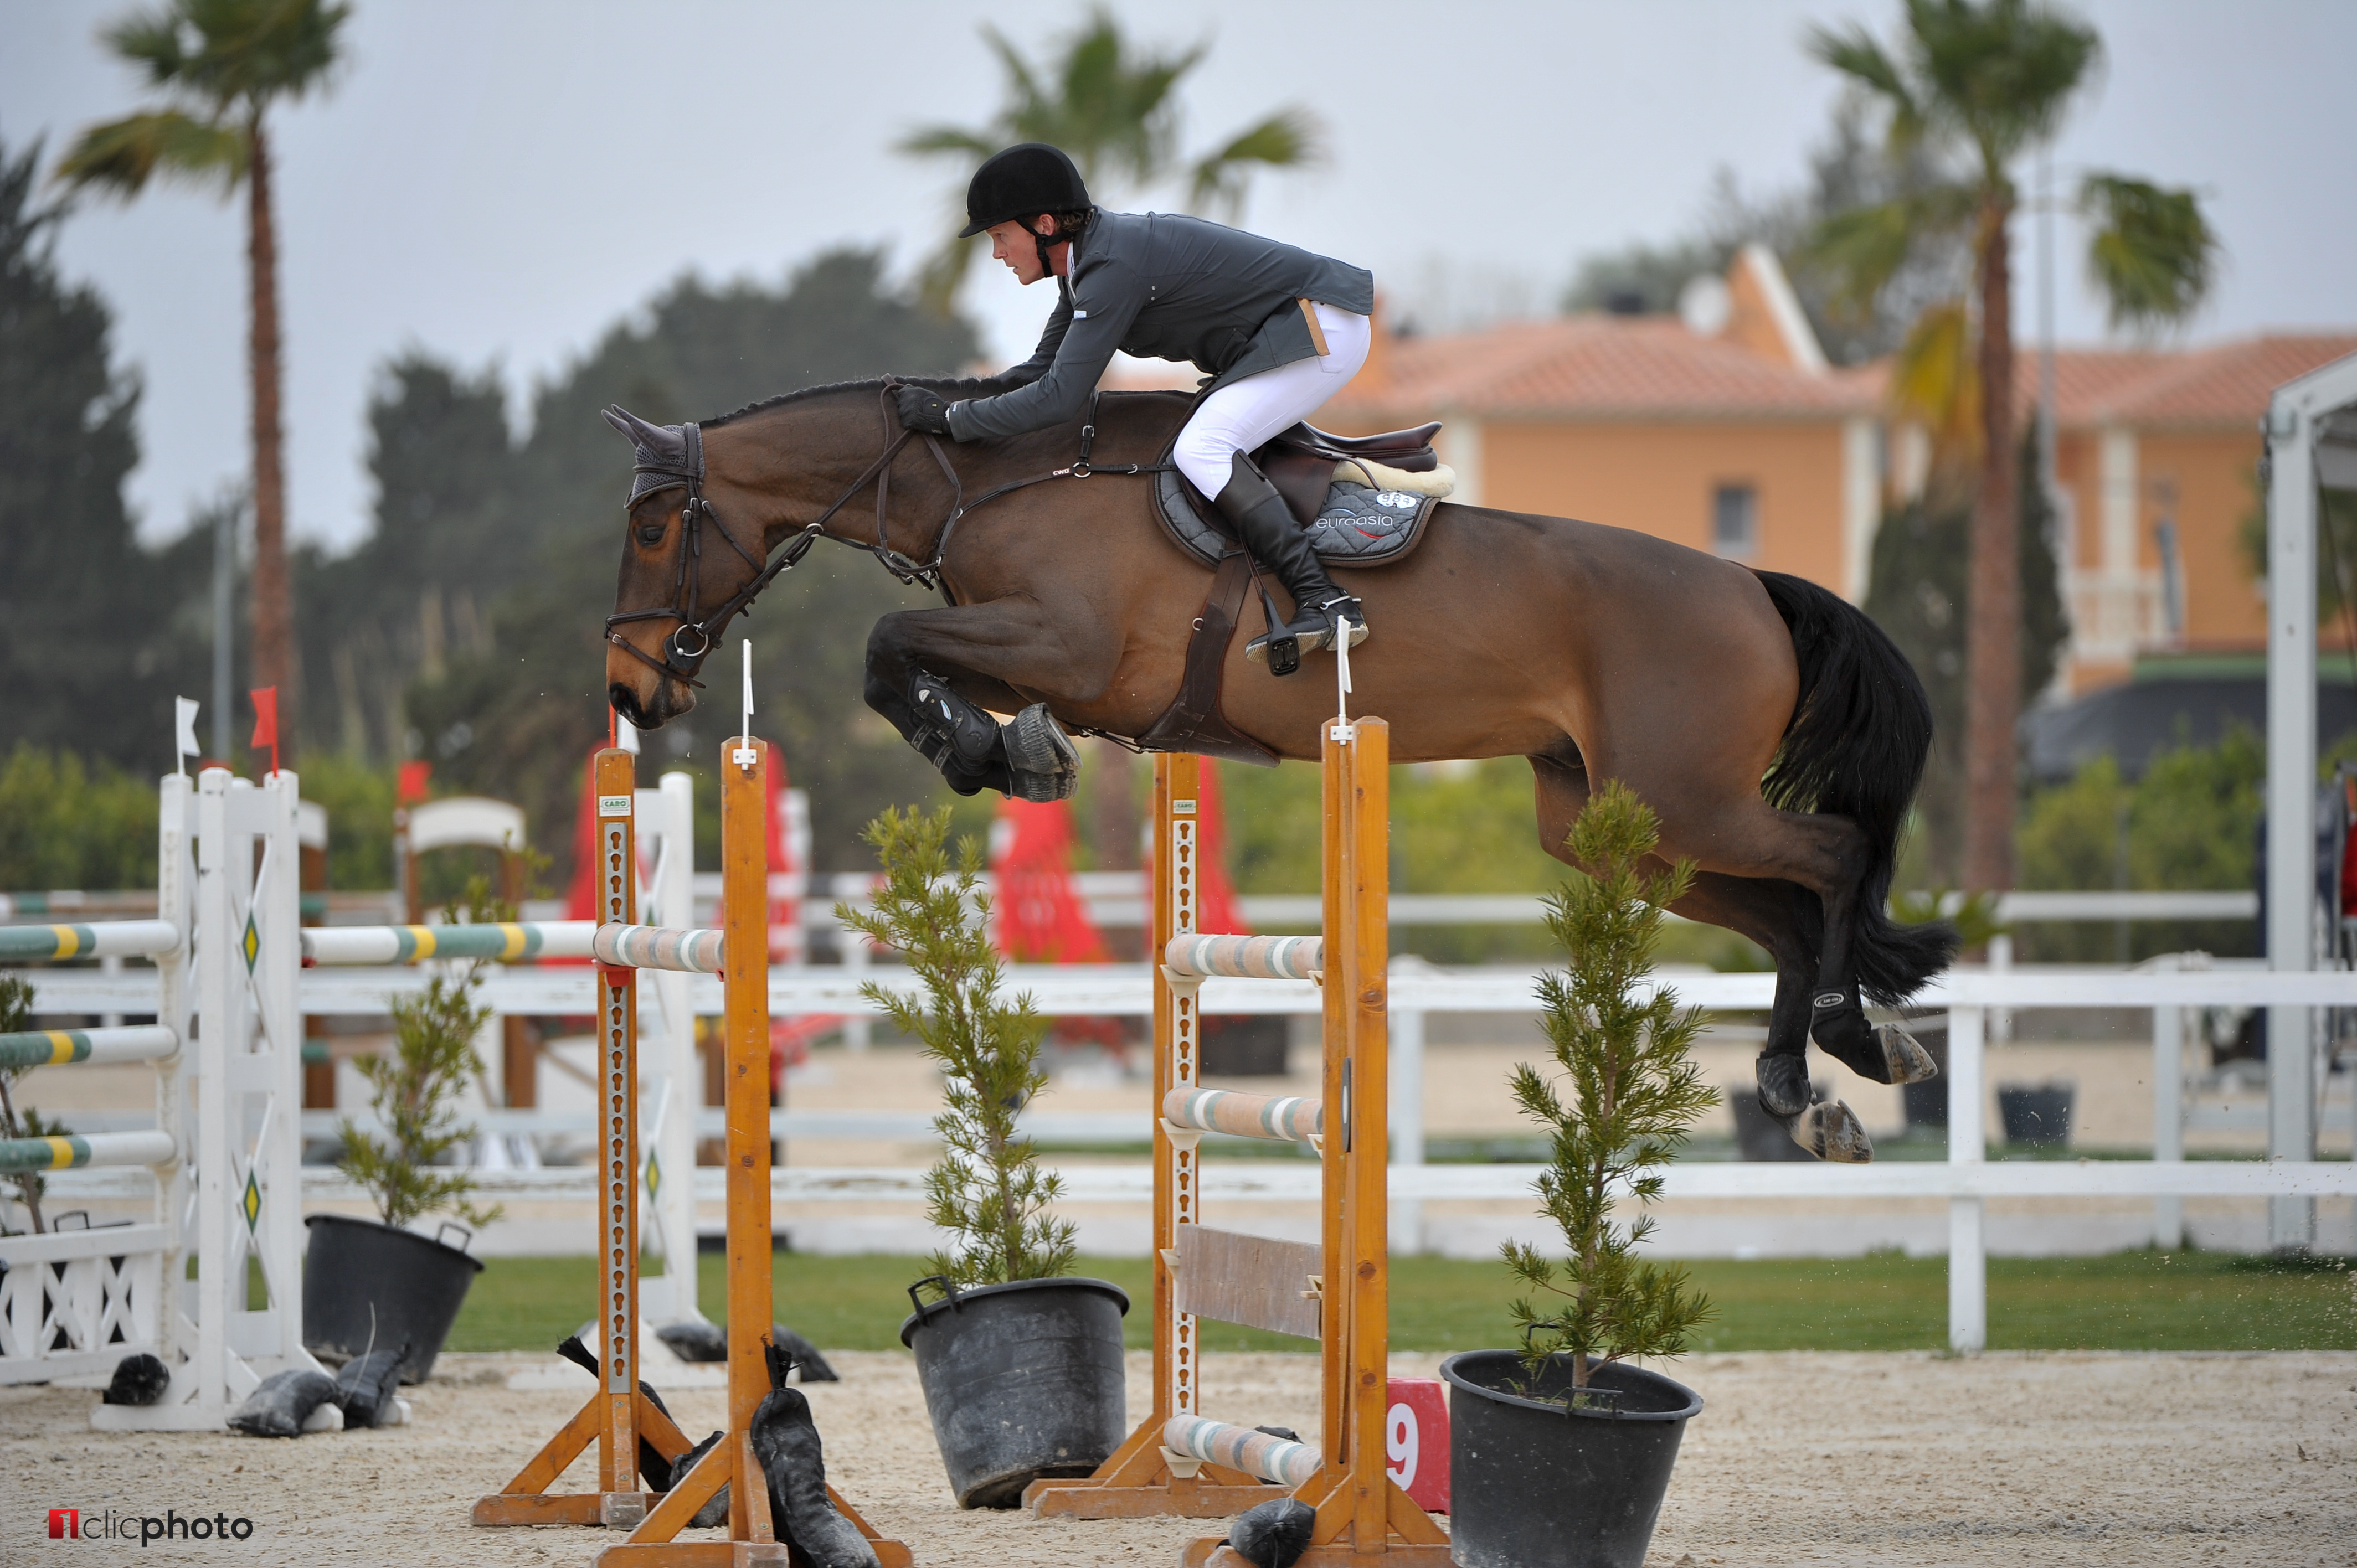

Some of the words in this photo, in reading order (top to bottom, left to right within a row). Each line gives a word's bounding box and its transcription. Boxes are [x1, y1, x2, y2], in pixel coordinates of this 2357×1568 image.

[1382, 494, 1410, 505] 984
[1316, 513, 1393, 529] euroasia
[1387, 1403, 1419, 1492] 9
